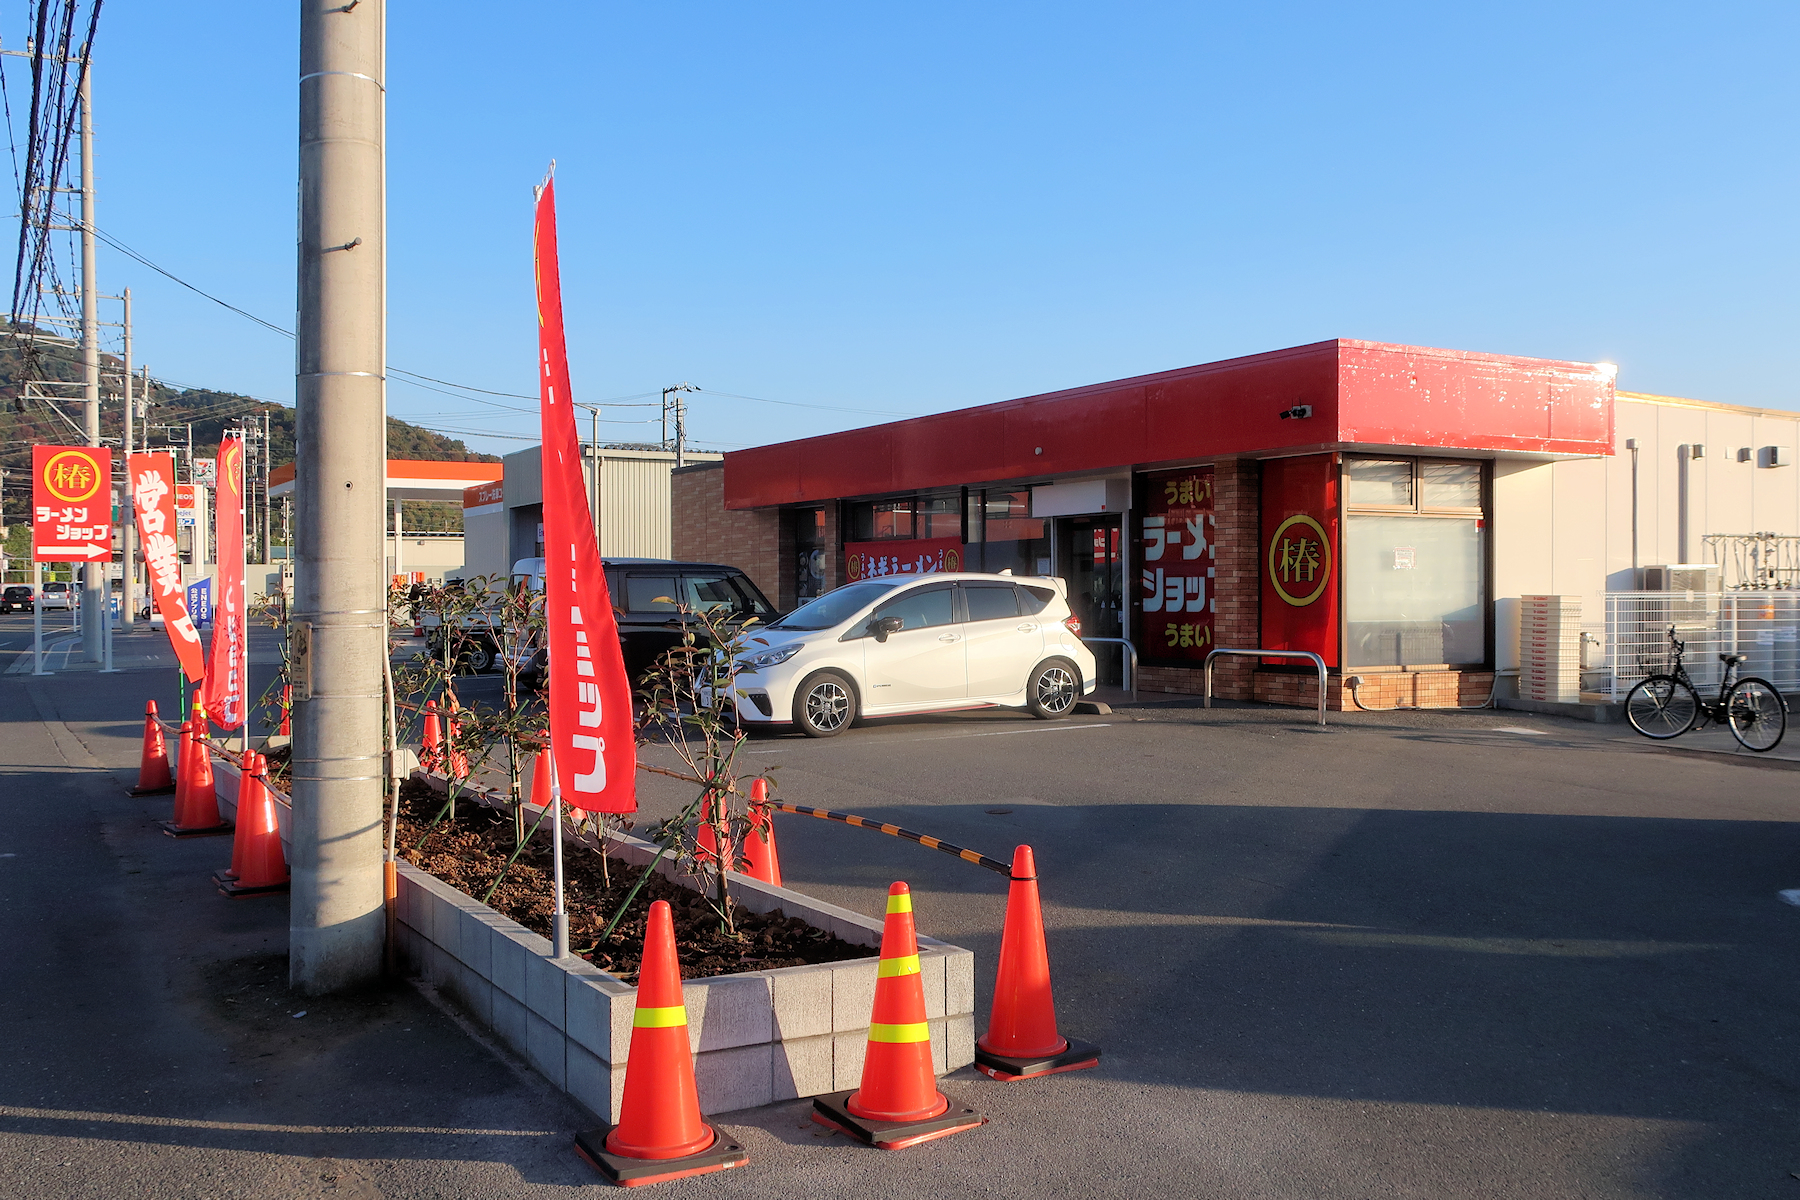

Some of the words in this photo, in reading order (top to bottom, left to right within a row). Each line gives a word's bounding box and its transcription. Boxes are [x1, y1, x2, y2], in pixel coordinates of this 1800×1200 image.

[53, 464, 90, 488] 椿
[1165, 480, 1211, 505] うまい
[36, 507, 87, 522] ラーメン
[56, 524, 109, 540] ショップ
[867, 555, 938, 577] ネギラーメン
[1279, 537, 1320, 583] 椿
[200, 588, 208, 620] ENEOS
[1165, 623, 1211, 648] うまい
